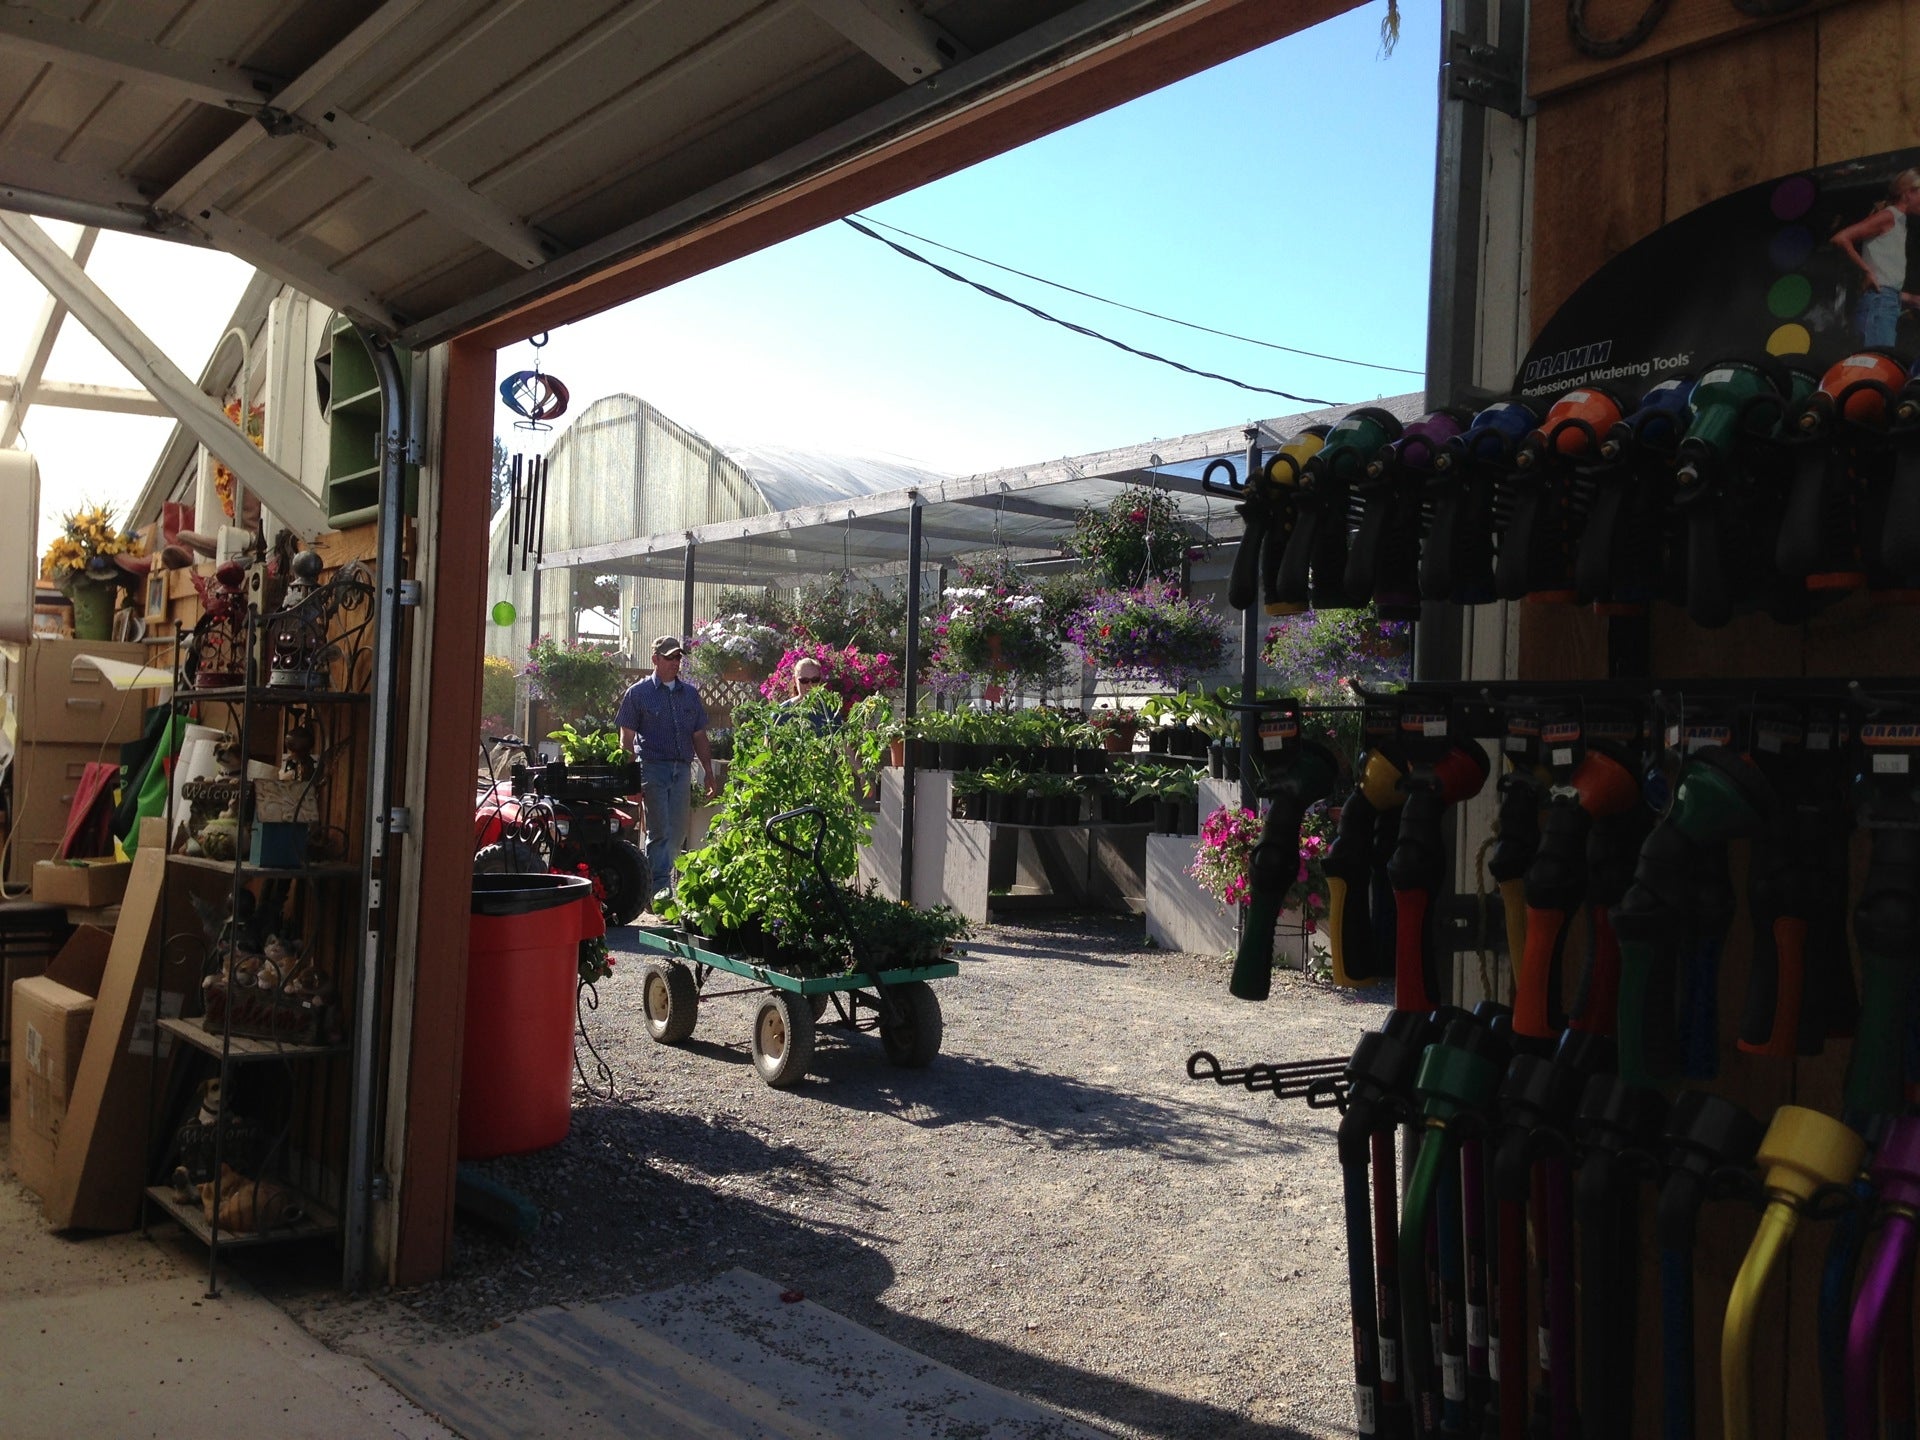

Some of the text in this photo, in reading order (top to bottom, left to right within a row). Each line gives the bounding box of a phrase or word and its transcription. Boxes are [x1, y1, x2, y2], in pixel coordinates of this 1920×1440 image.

[1521, 374, 1587, 398] Professional
[1589, 360, 1651, 381] Watering
[1652, 352, 1690, 371] Tools
[1523, 339, 1613, 384] DRAMM
[1862, 725, 1920, 737] DRAM
